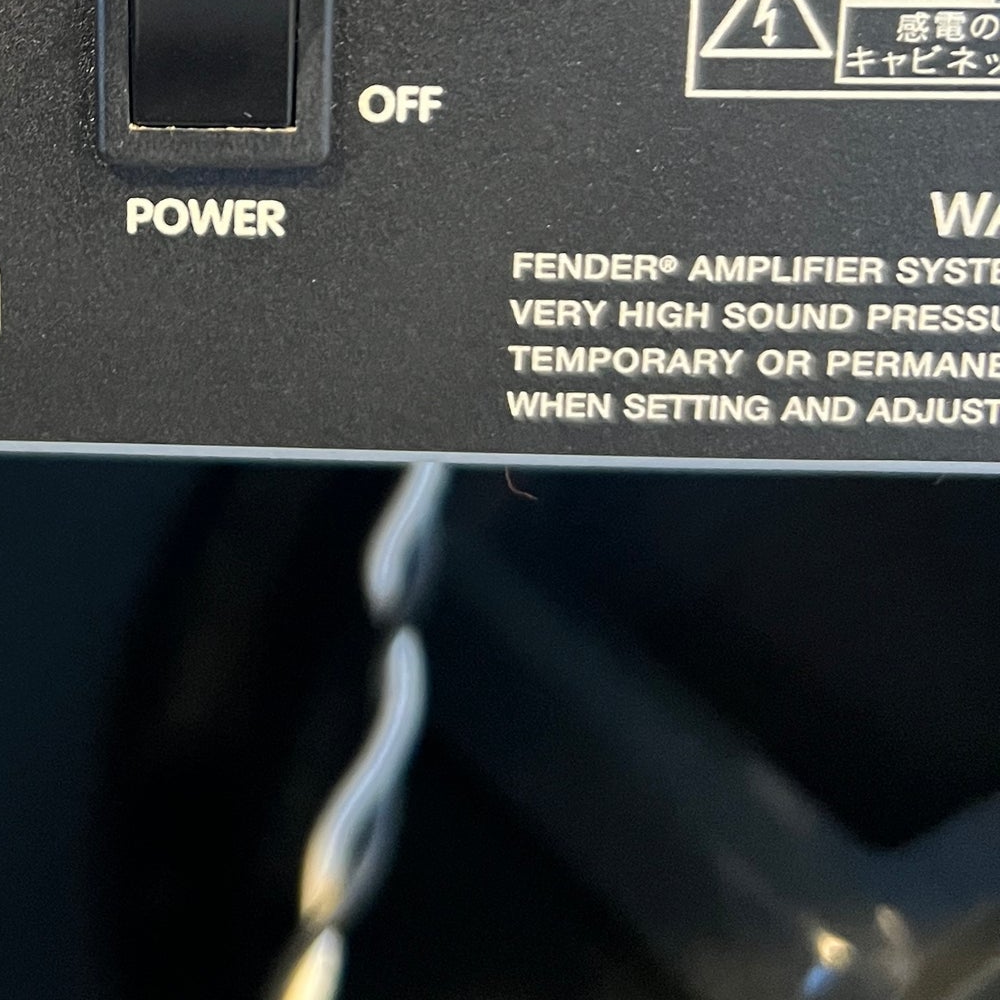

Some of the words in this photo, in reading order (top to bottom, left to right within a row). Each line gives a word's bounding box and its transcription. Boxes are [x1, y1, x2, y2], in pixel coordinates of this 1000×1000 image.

[358, 85, 443, 123] OFF
[127, 197, 285, 237] POWER
[688, 255, 883, 283] AMPLIFIER
[510, 299, 606, 326] VERY
[619, 300, 710, 328] HIGH
[722, 302, 853, 330] SOUND
[508, 346, 742, 374] TEMPORARY
[757, 350, 810, 376] OR
[506, 391, 611, 419] WHEN
[623, 393, 770, 422] SETTING
[781, 396, 855, 423] AND
[866, 398, 1000, 425] ADJUST
